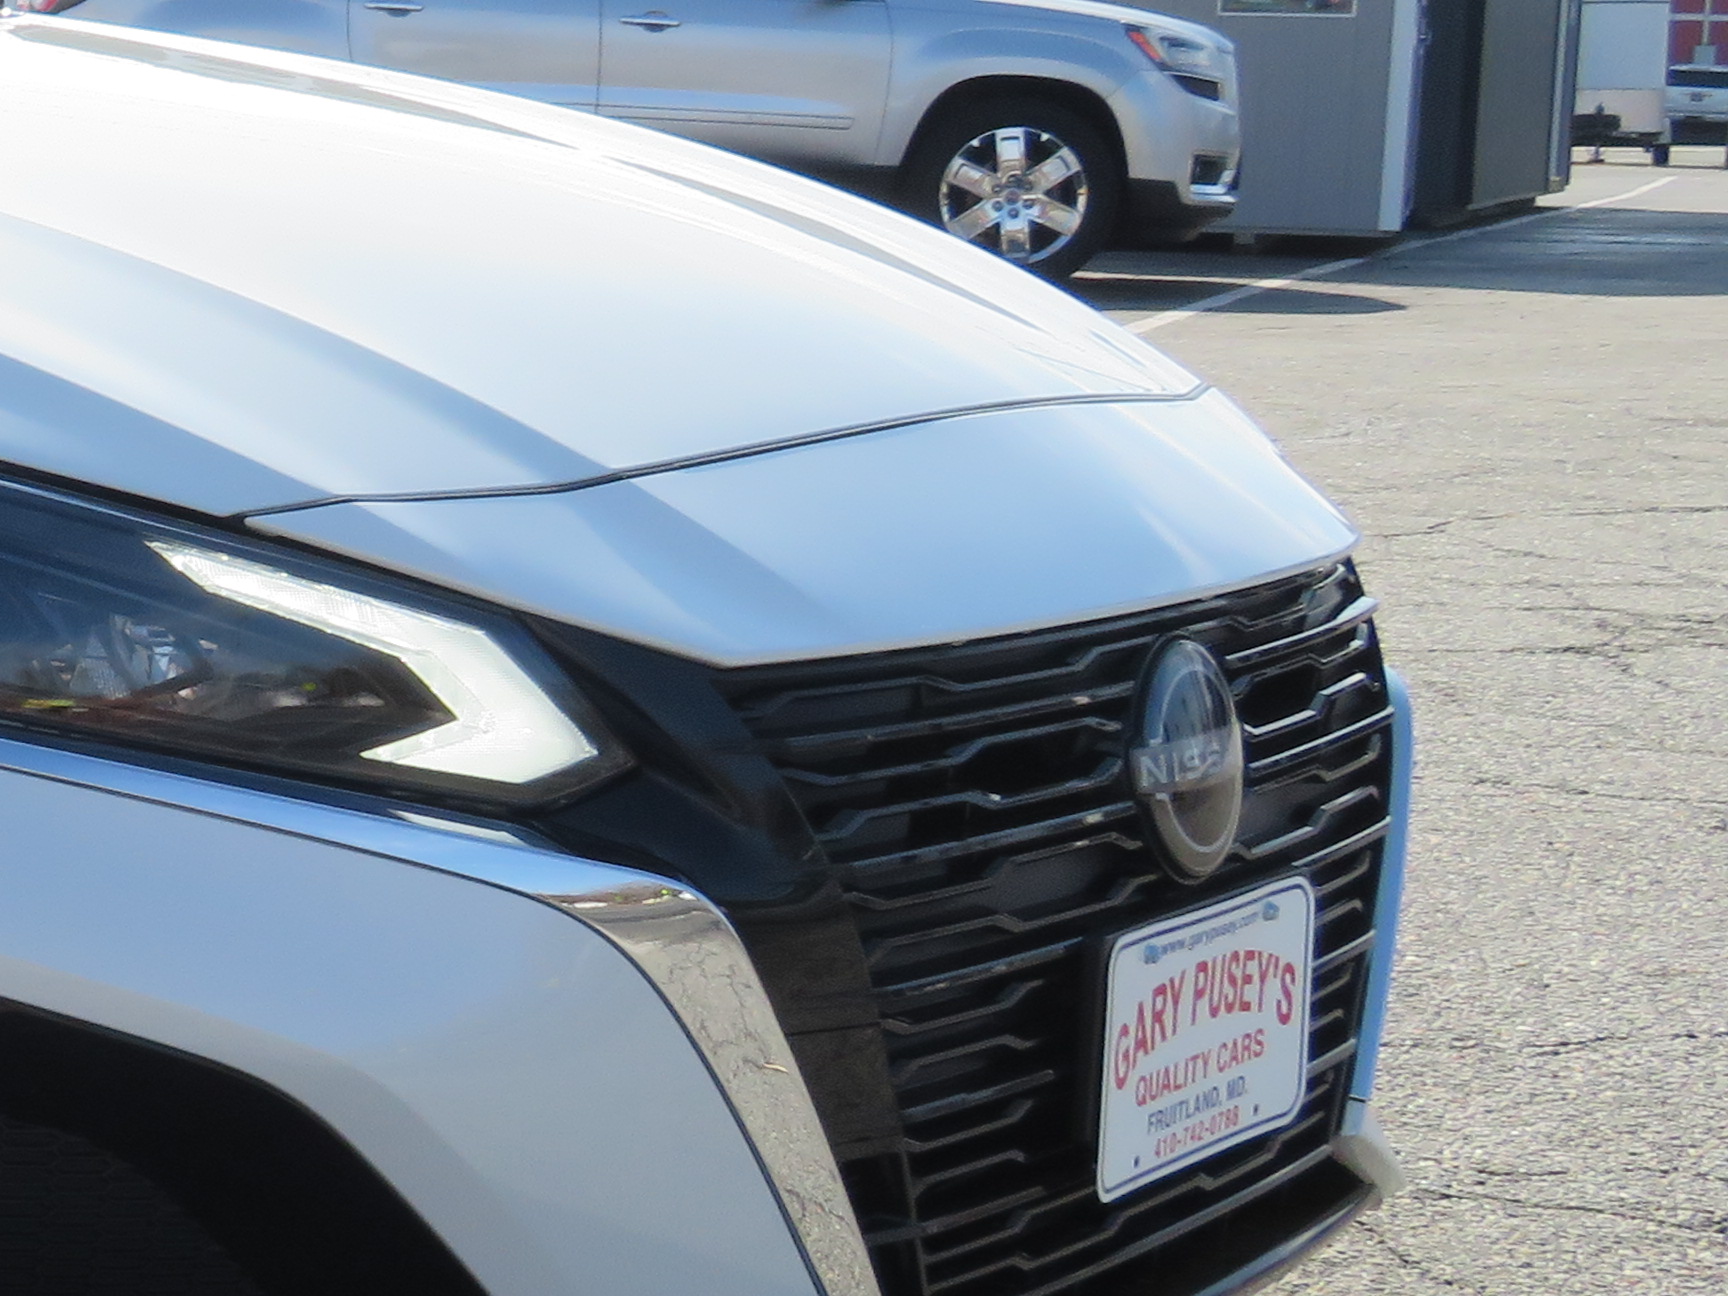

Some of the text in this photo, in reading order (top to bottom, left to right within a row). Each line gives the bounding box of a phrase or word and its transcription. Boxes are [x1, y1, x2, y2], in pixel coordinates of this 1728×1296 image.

[1114, 949, 1297, 1090] GARY PUSEY'S
[1135, 1028, 1265, 1107] QUALITY CARS
